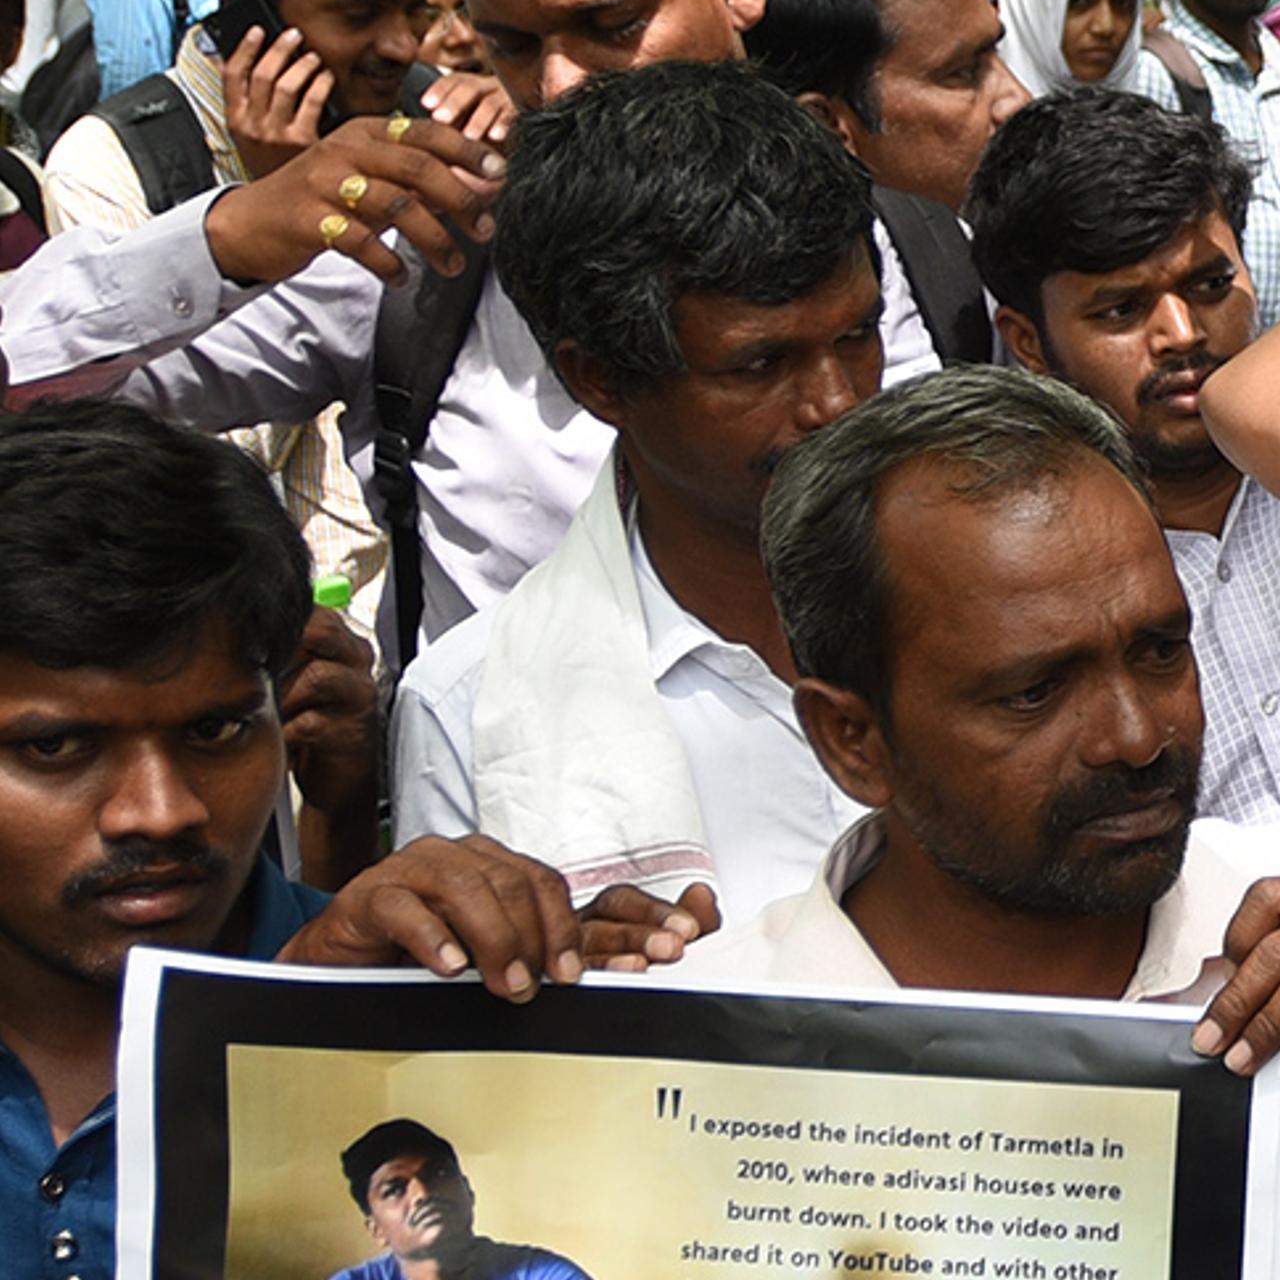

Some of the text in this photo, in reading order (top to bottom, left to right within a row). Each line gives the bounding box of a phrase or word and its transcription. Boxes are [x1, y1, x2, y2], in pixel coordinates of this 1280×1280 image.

[703, 1119, 802, 1141] exposed
[809, 1122, 847, 1144] the
[854, 1124, 951, 1150] incident
[959, 1131, 984, 1151] of
[989, 1132, 1095, 1158] Tarmetla
[1102, 1137, 1124, 1159] in
[737, 1159, 1122, 1200] 2010, where adivasi houses were
[727, 1200, 1120, 1242] burnt down. I took the video and
[681, 1241, 760, 1264] shared
[767, 1244, 784, 1266] it
[790, 1251, 820, 1267] on
[828, 1250, 933, 1273] YouTube
[941, 1257, 985, 1277] and
[993, 1259, 1046, 1280] with
